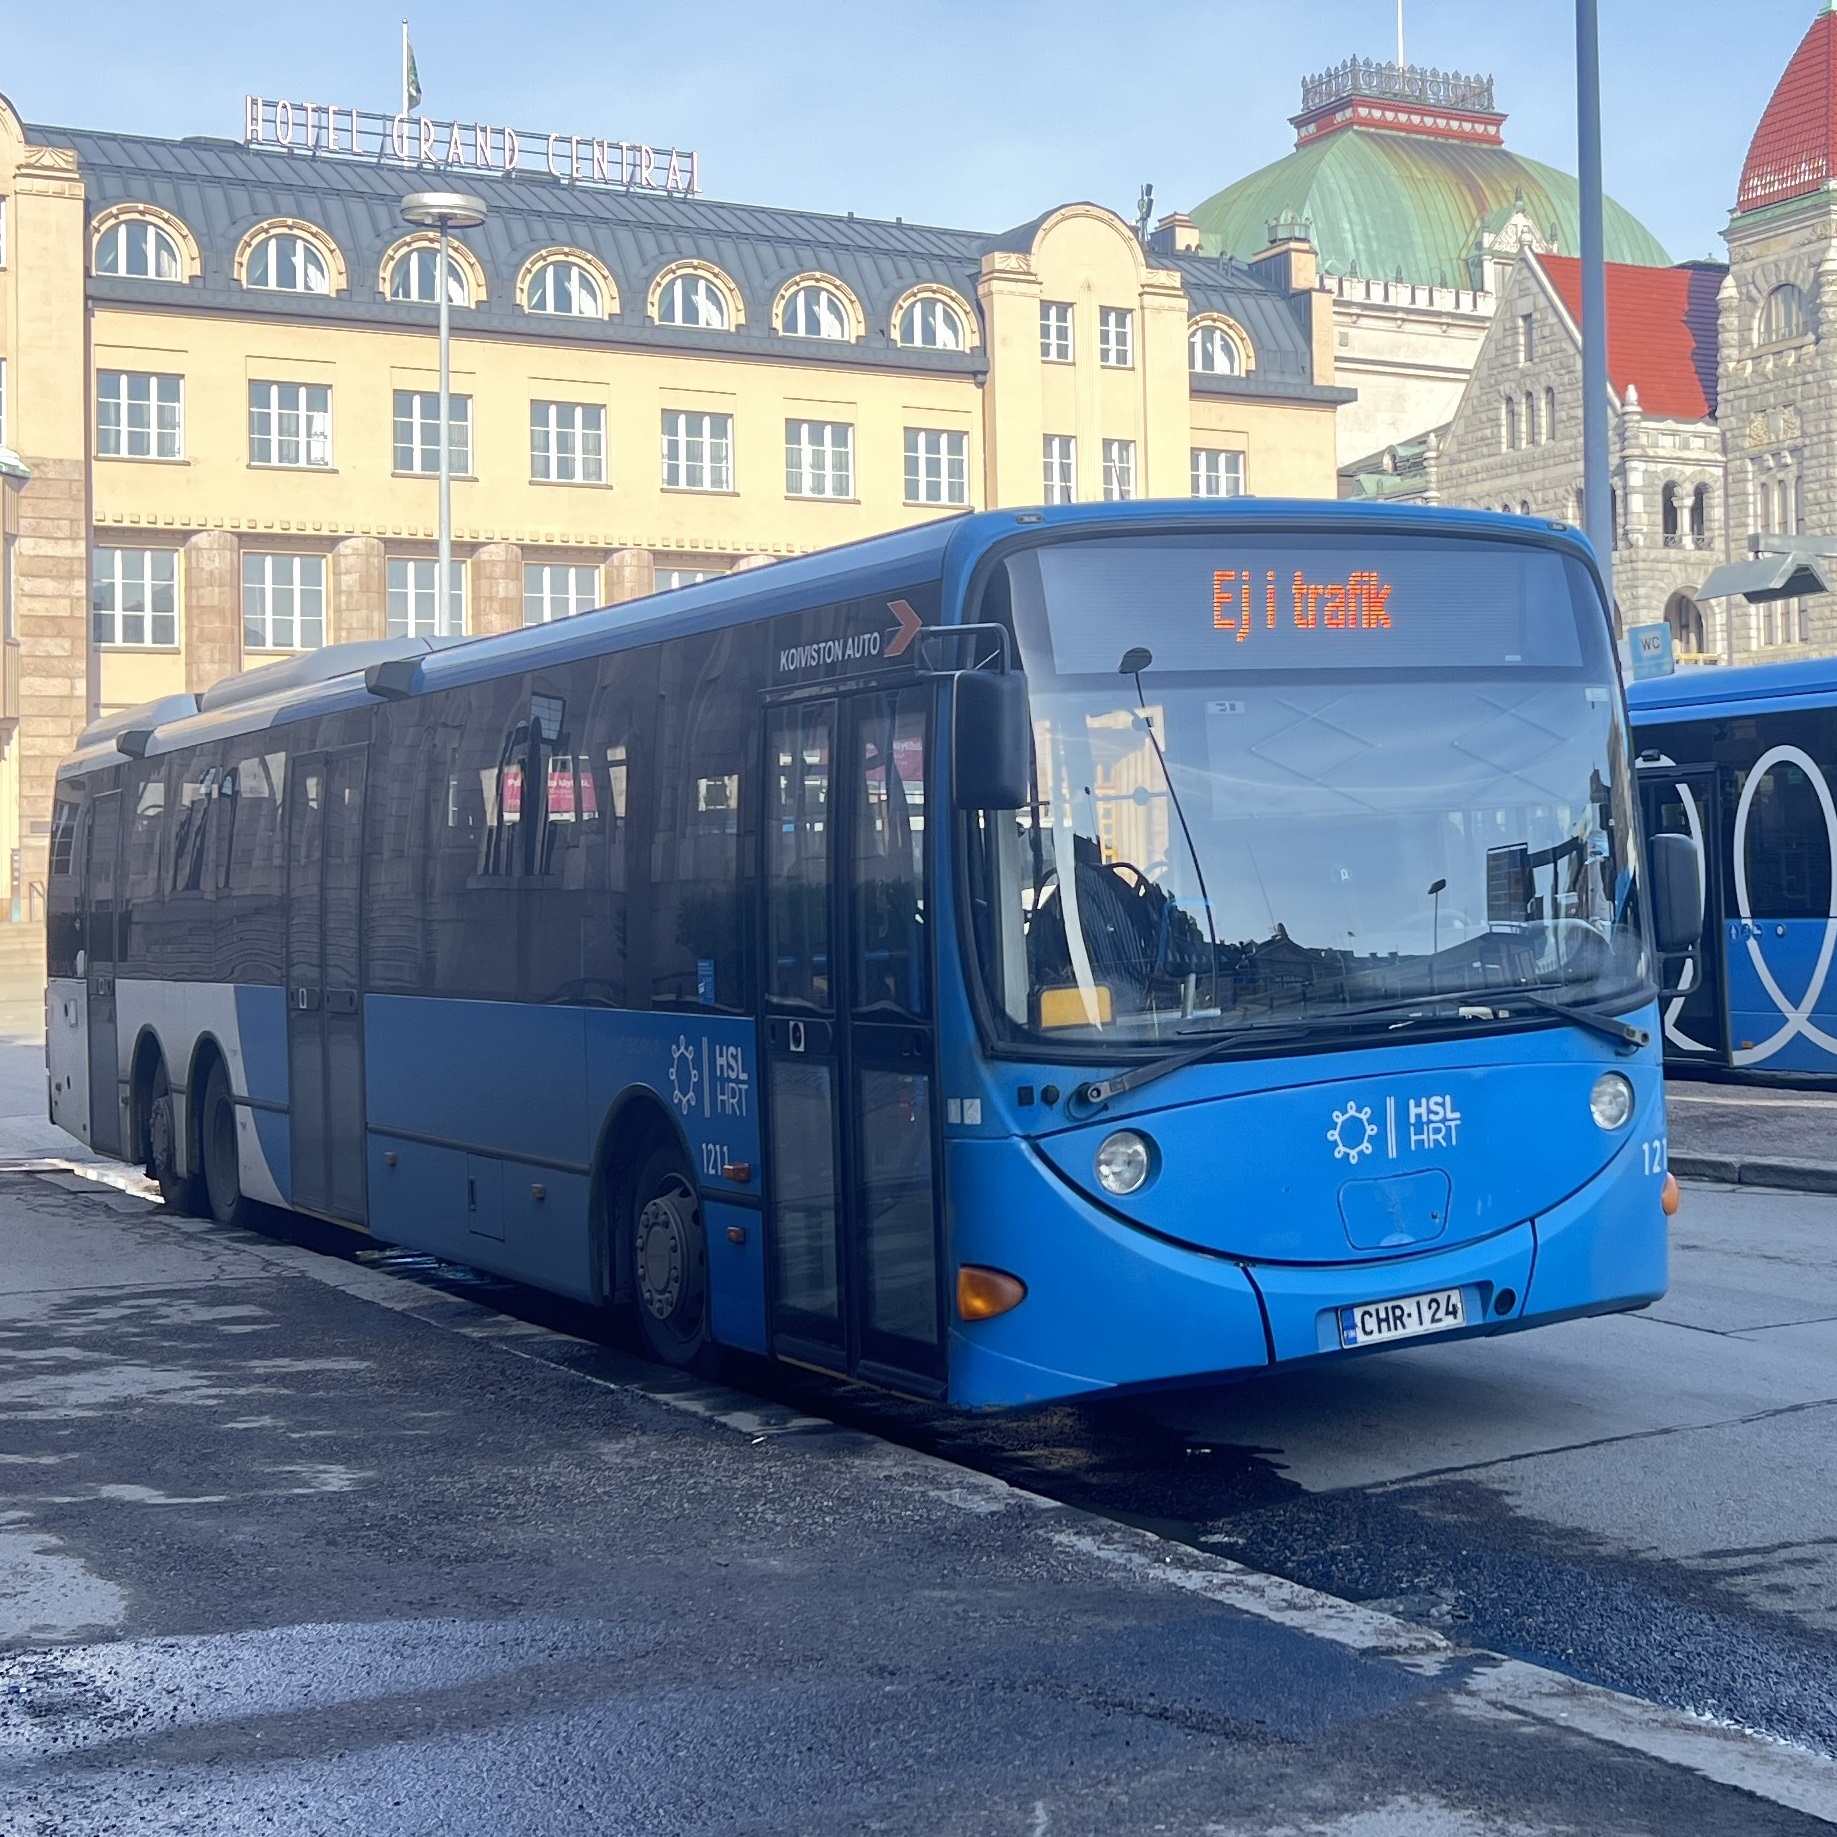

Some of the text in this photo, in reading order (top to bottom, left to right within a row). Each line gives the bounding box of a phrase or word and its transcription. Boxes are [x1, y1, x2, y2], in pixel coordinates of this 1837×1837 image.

[246, 95, 703, 193] HOTEL GRAND CENTRAL
[1213, 570, 1392, 643] Ej i trafik
[780, 631, 880, 672] KOIVISTON AUTO
[1641, 636, 1660, 651] WC
[716, 1044, 748, 1080] HSL
[717, 1080, 748, 1117] HRT
[1409, 1094, 1461, 1124] HSL
[1410, 1120, 1461, 1151] HRT
[702, 1142, 729, 1176] 1211
[1360, 1294, 1459, 1336] CHR-124
